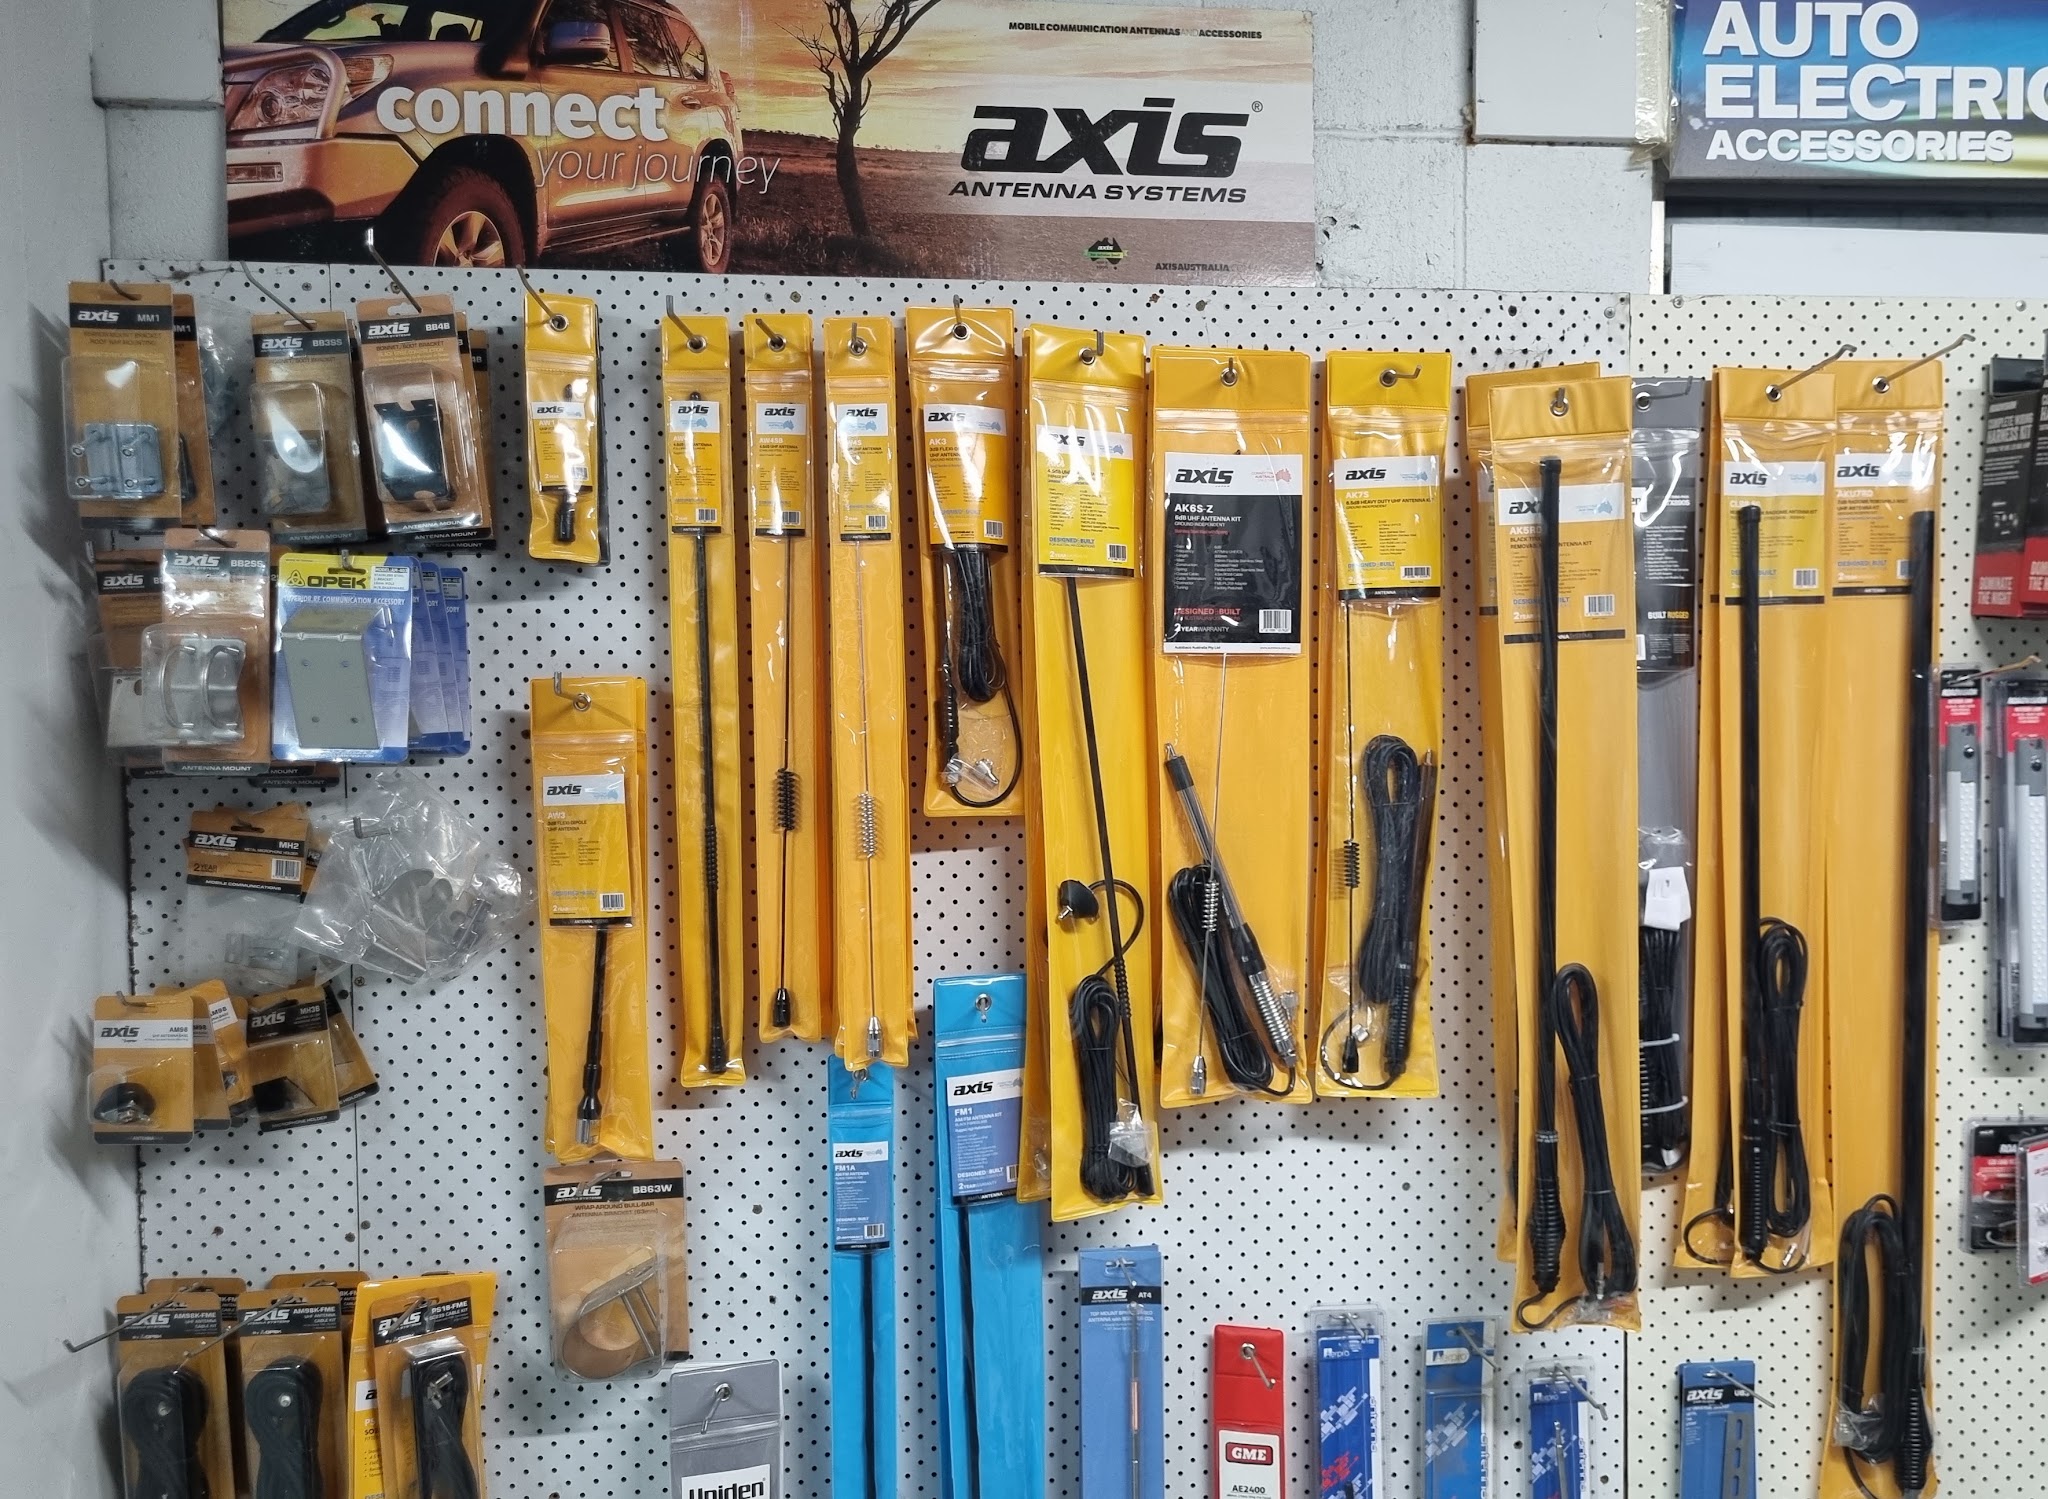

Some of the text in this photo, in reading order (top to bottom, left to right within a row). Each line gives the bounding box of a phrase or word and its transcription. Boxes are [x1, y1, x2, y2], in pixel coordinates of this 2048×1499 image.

[1009, 22, 1262, 39] MOBILE COMMUNICATION ANTENNAS ACCESSORIES
[1702, 1, 1919, 58] AUTO
[377, 86, 669, 141] connect
[960, 97, 1249, 178] axis
[1706, 129, 2014, 162] ACCESSORIES
[535, 145, 780, 194] your journey
[949, 181, 1247, 203] ANTENNA SYSTEMS
[77, 310, 160, 322] axis MM1
[368, 322, 451, 336] axis BB4B
[261, 336, 343, 349] axis BB3SS
[536, 405, 564, 414] axis
[677, 404, 709, 414] axis
[764, 407, 796, 417] axis
[929, 438, 947, 446] AK3
[1175, 467, 1234, 484] axis
[1345, 468, 1386, 481] axis
[1837, 464, 1880, 478] axis
[1730, 471, 1768, 486] axis
[1346, 491, 1369, 499] AK7S
[1174, 504, 1214, 513] AK6S-Z
[403, 522, 437, 531] ANTENNA
[173, 554, 220, 567] axis
[1049, 550, 1055, 558] 2
[103, 573, 144, 587] axis
[307, 576, 367, 589] OPEK
[374, 597, 406, 606] ACCESSORY
[1513, 612, 1520, 620] 2
[1647, 611, 1667, 620] BUILT
[547, 783, 582, 796] axis
[547, 811, 566, 820] AW3
[195, 834, 299, 850] axis MH2
[193, 863, 200, 872] 2
[251, 1011, 286, 1028] axis
[100, 1025, 140, 1037] axis
[954, 1081, 993, 1096] axis
[954, 1107, 973, 1116] FM1
[835, 1149, 863, 1158] axis
[957, 1166, 1004, 1179] DESIGNED BUILT
[632, 1184, 673, 1195] BB63W
[981, 1191, 1003, 1199] ANTENNA
[574, 1203, 623, 1211] WRAP-AROUND
[1092, 1288, 1128, 1300] axis
[1687, 1387, 1724, 1402] axis
[1231, 1446, 1267, 1461] GME
[1232, 1485, 1266, 1494] AE2400
